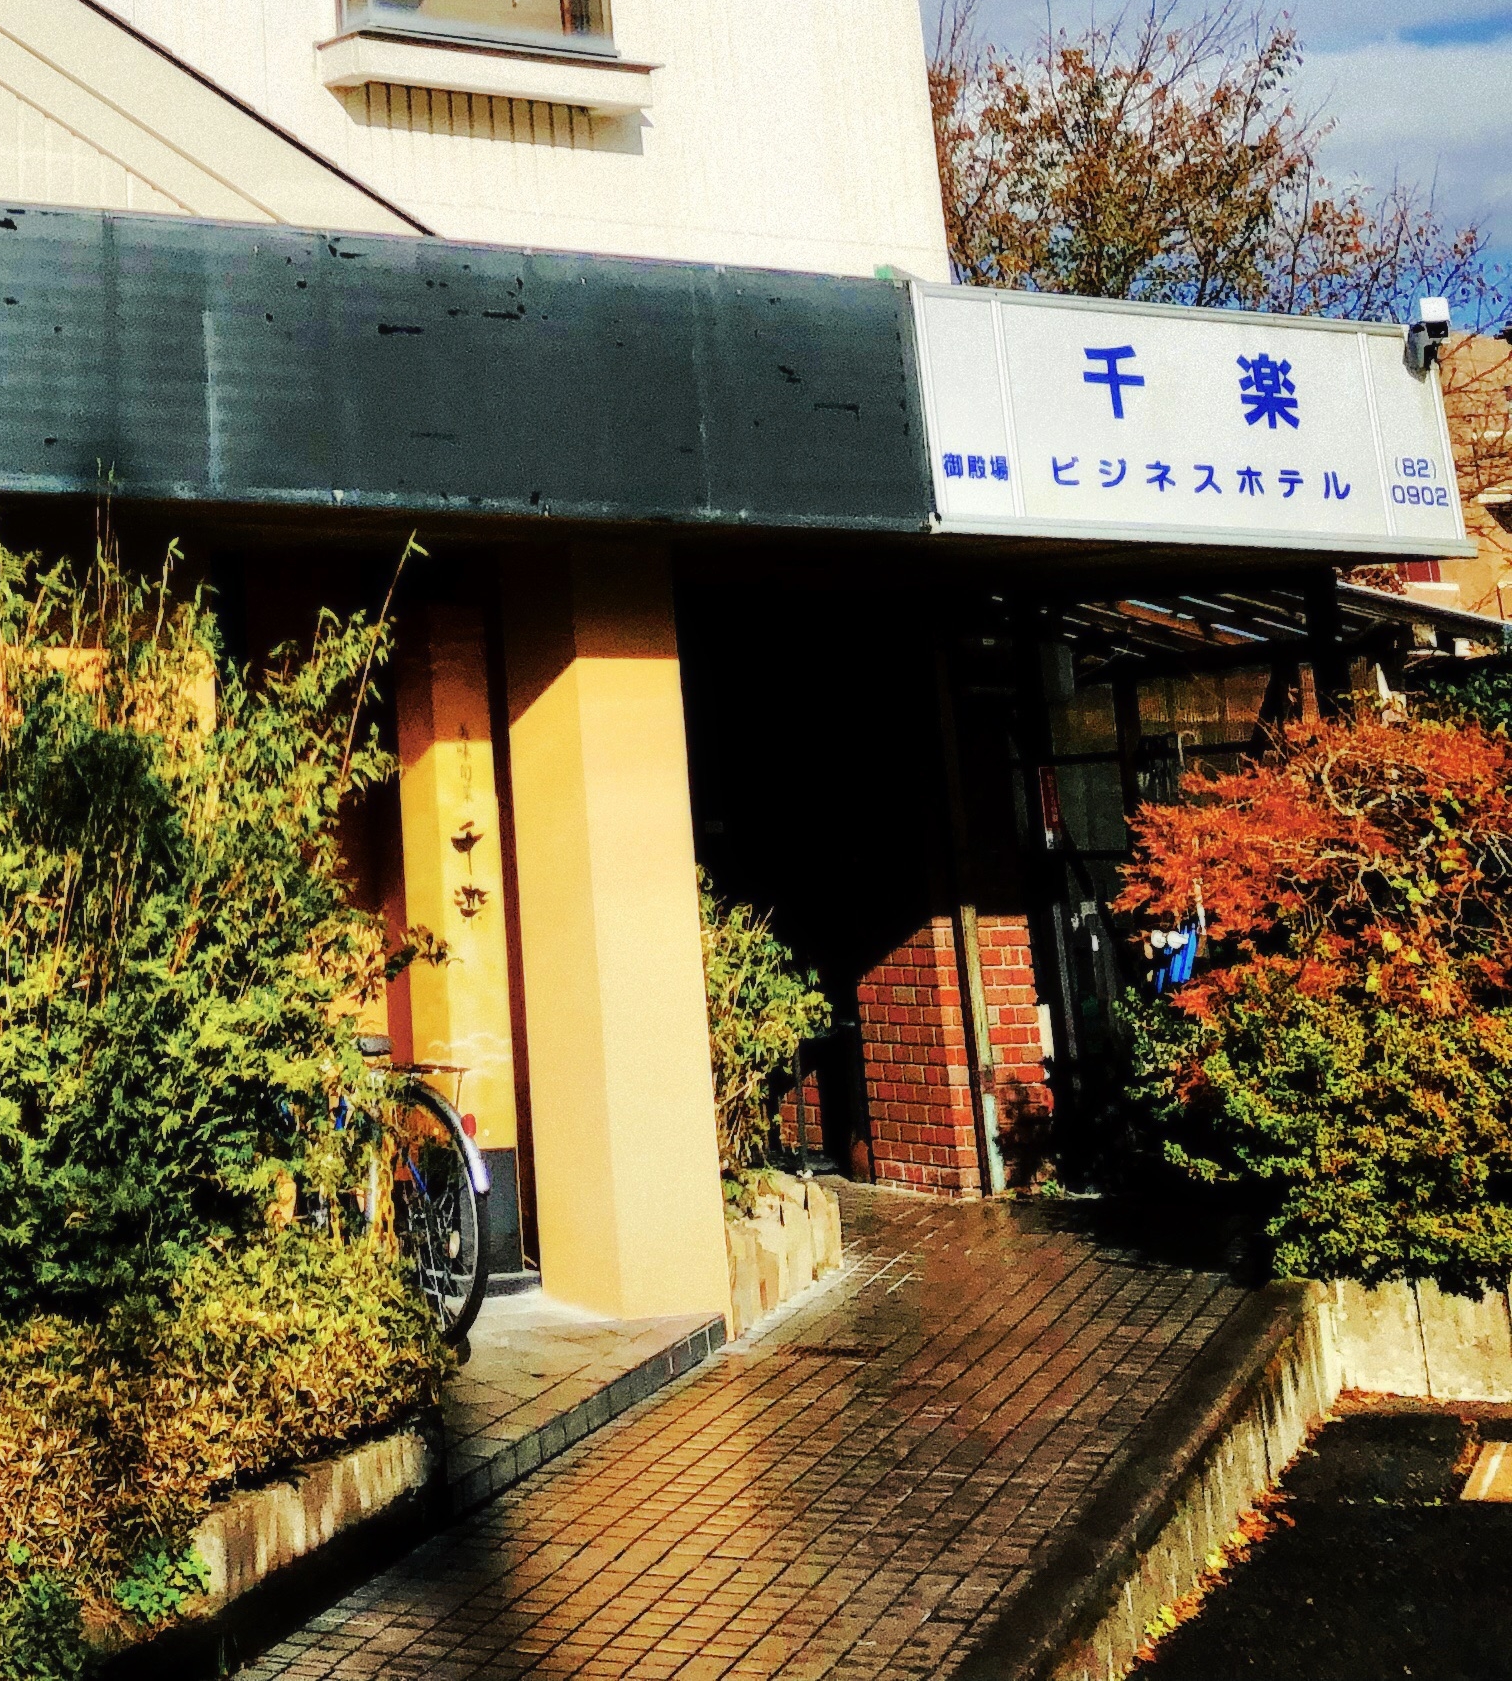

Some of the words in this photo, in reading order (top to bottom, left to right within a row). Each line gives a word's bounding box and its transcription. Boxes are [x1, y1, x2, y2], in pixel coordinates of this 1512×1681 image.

[1083, 345, 1301, 429] 千楽
[942, 452, 1009, 481] 御殿場
[1051, 455, 1351, 501] ビジネスホテル
[1394, 456, 1437, 479] (82)
[1392, 484, 1449, 507] 0902
